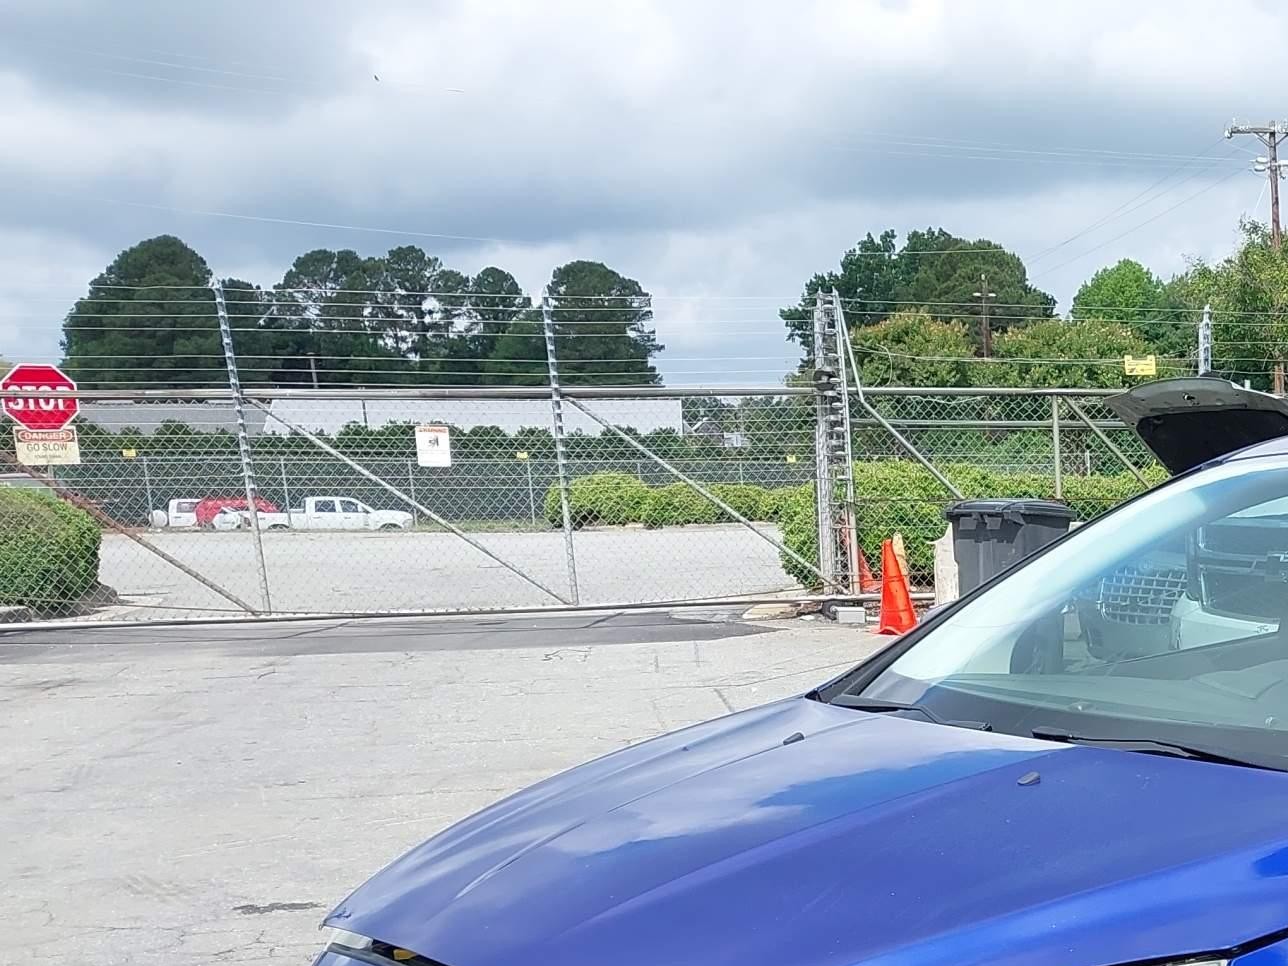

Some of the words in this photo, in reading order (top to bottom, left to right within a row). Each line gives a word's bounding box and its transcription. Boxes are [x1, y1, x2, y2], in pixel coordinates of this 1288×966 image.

[7, 385, 71, 411] STOP
[24, 432, 67, 440] DANGER
[27, 443, 40, 452] GO
[42, 442, 68, 451] SLOW
